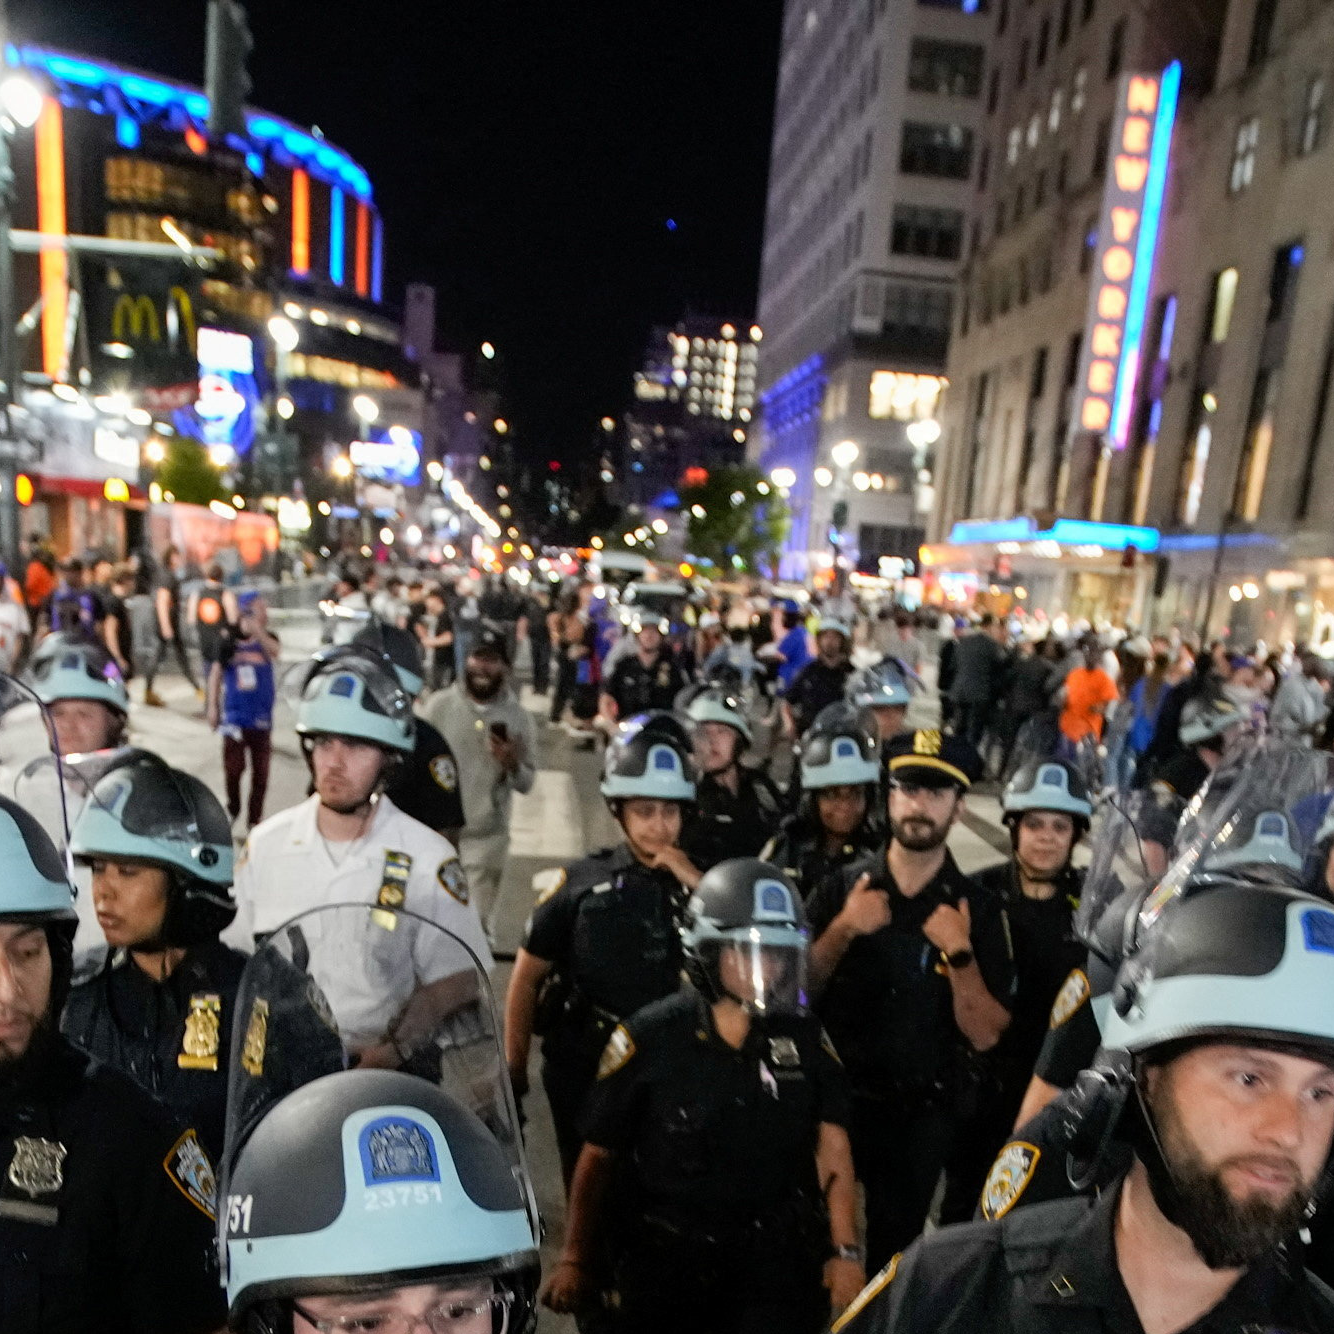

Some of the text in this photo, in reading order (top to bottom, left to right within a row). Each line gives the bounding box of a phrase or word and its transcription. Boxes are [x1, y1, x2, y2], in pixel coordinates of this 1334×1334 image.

[1080, 74, 1159, 431] NEW YORKER
[364, 1184, 444, 1211] 23751
